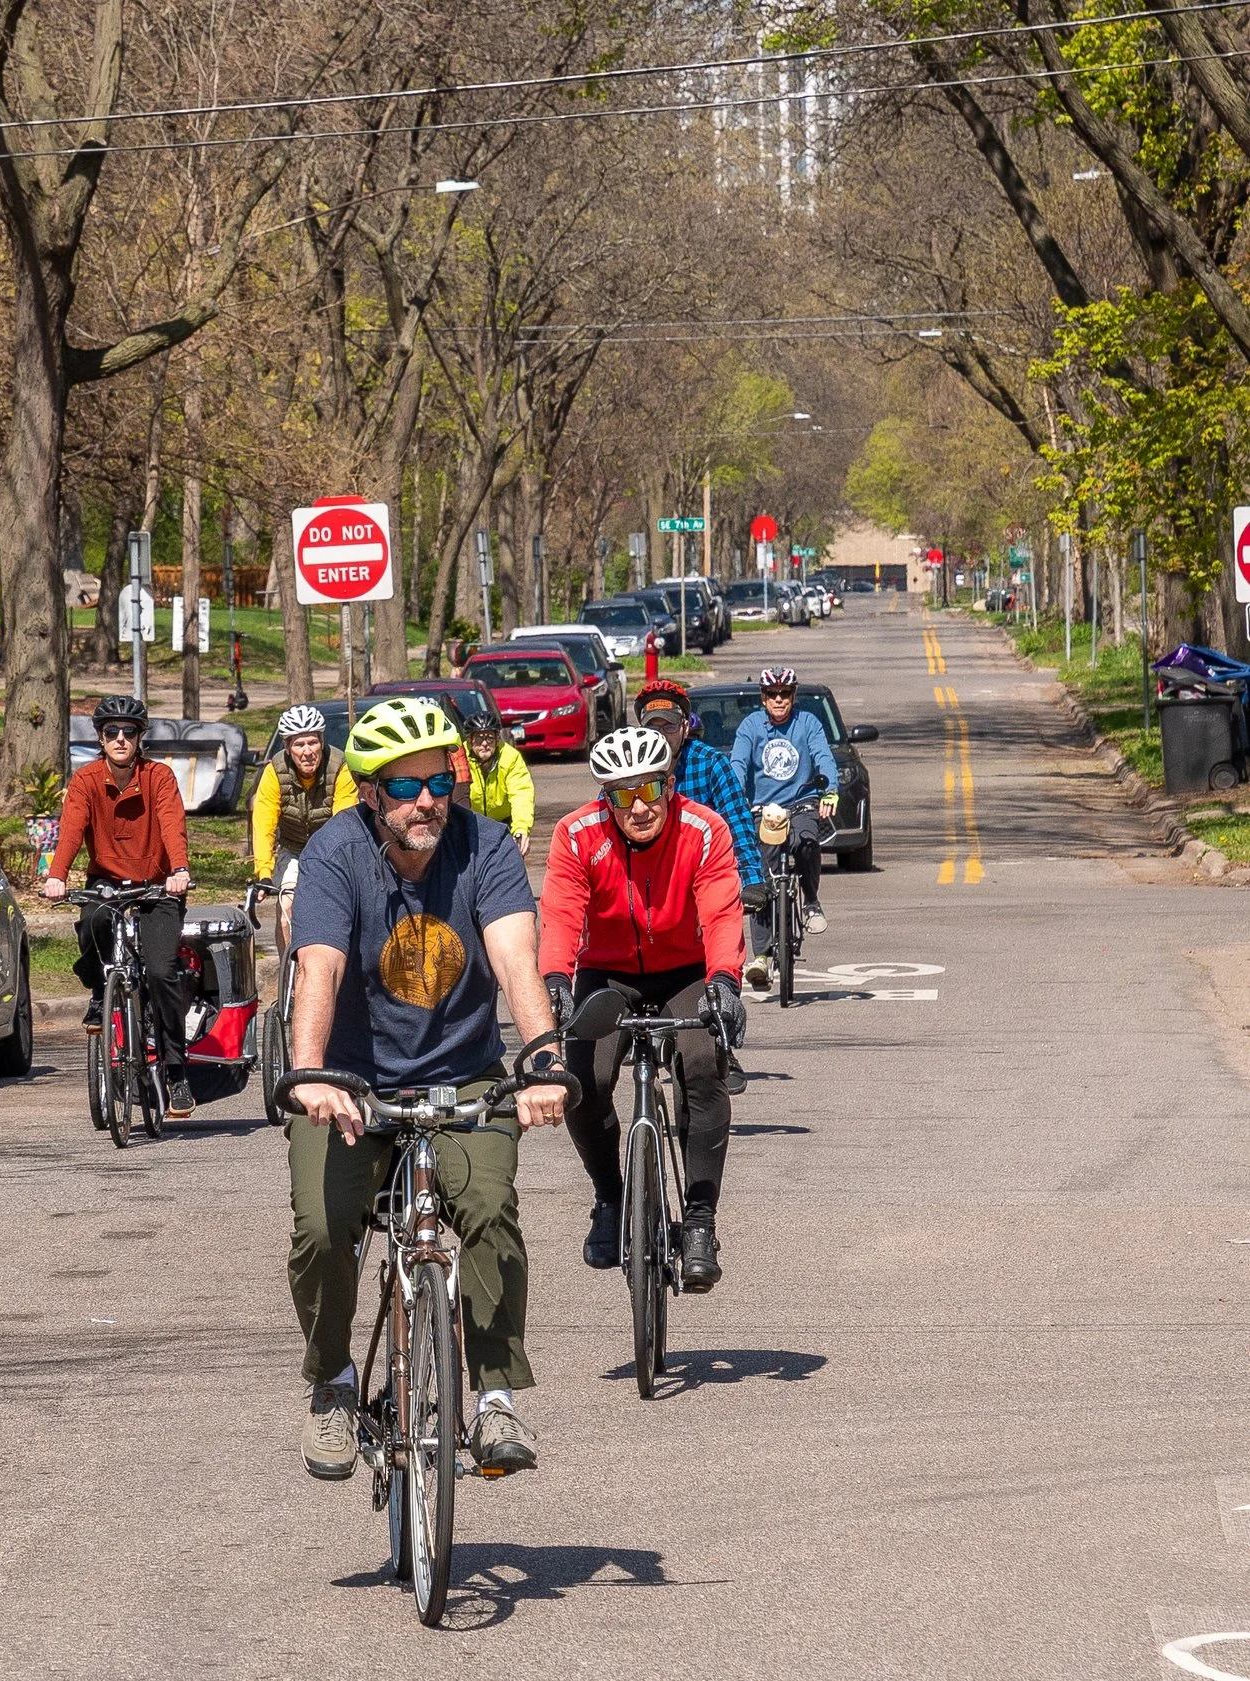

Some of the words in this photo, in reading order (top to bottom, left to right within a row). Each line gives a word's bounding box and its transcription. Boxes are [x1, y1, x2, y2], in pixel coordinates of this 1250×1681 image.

[308, 527, 332, 543] DO
[342, 524, 374, 541] NOT
[660, 520, 671, 530] SE
[675, 520, 689, 530] 7th
[693, 520, 704, 529] Av
[317, 566, 370, 584] ENTER
